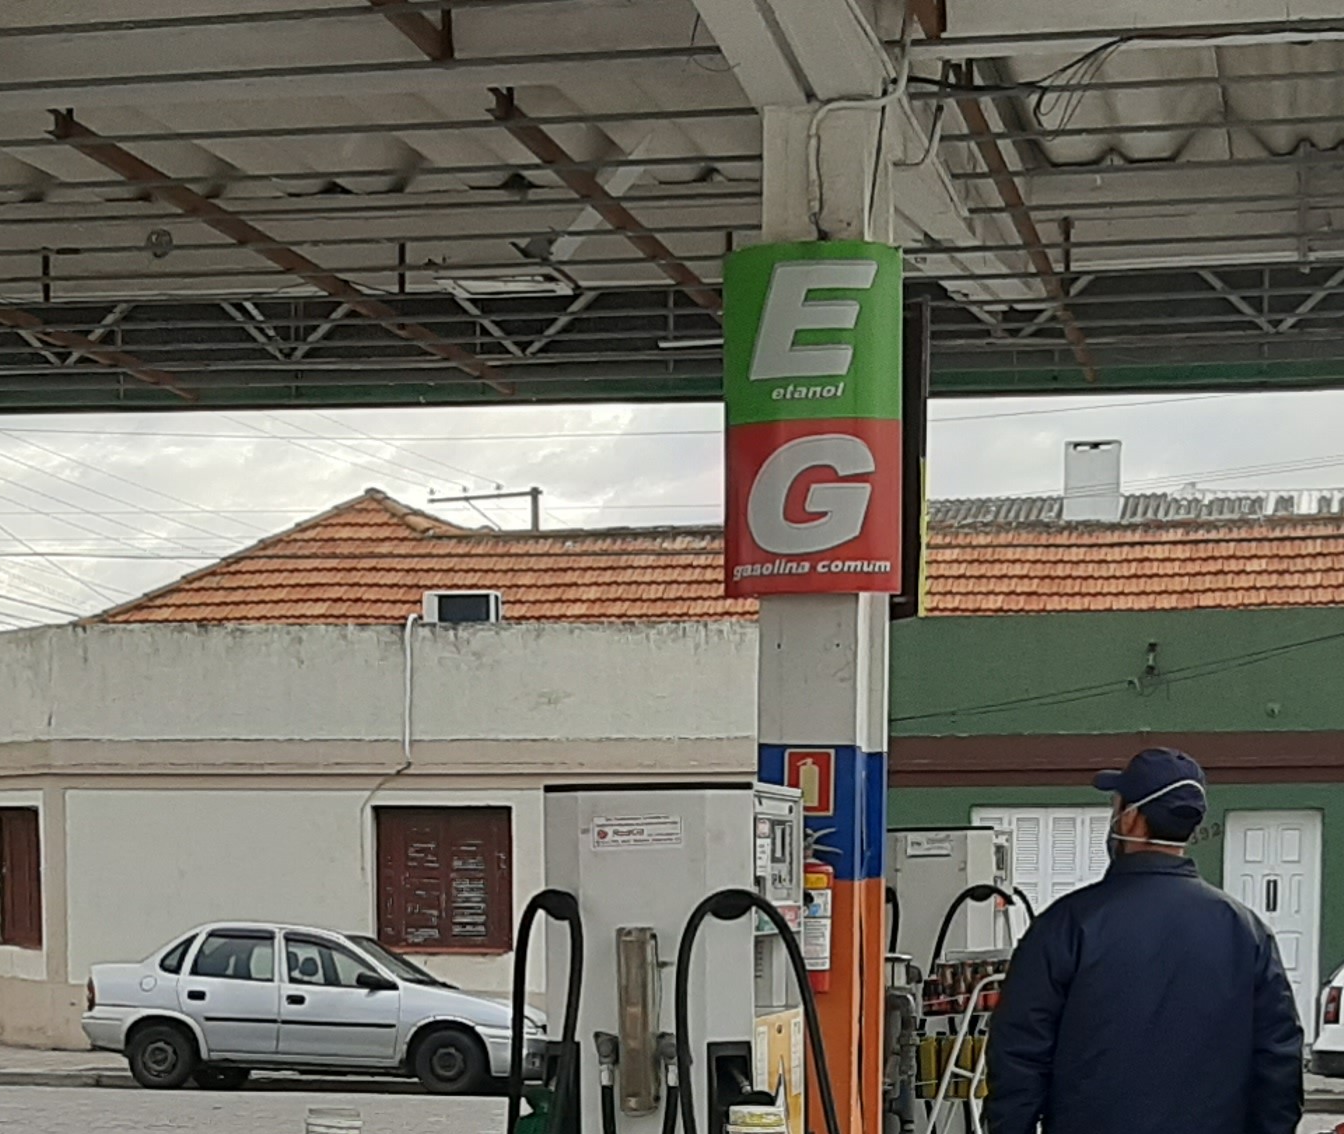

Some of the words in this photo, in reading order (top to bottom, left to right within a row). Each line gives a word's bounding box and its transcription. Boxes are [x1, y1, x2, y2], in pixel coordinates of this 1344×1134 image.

[749, 259, 878, 381] E
[771, 382, 844, 401] etanol
[747, 433, 876, 555] G
[733, 558, 811, 581] gasolina
[816, 559, 892, 574] comum
